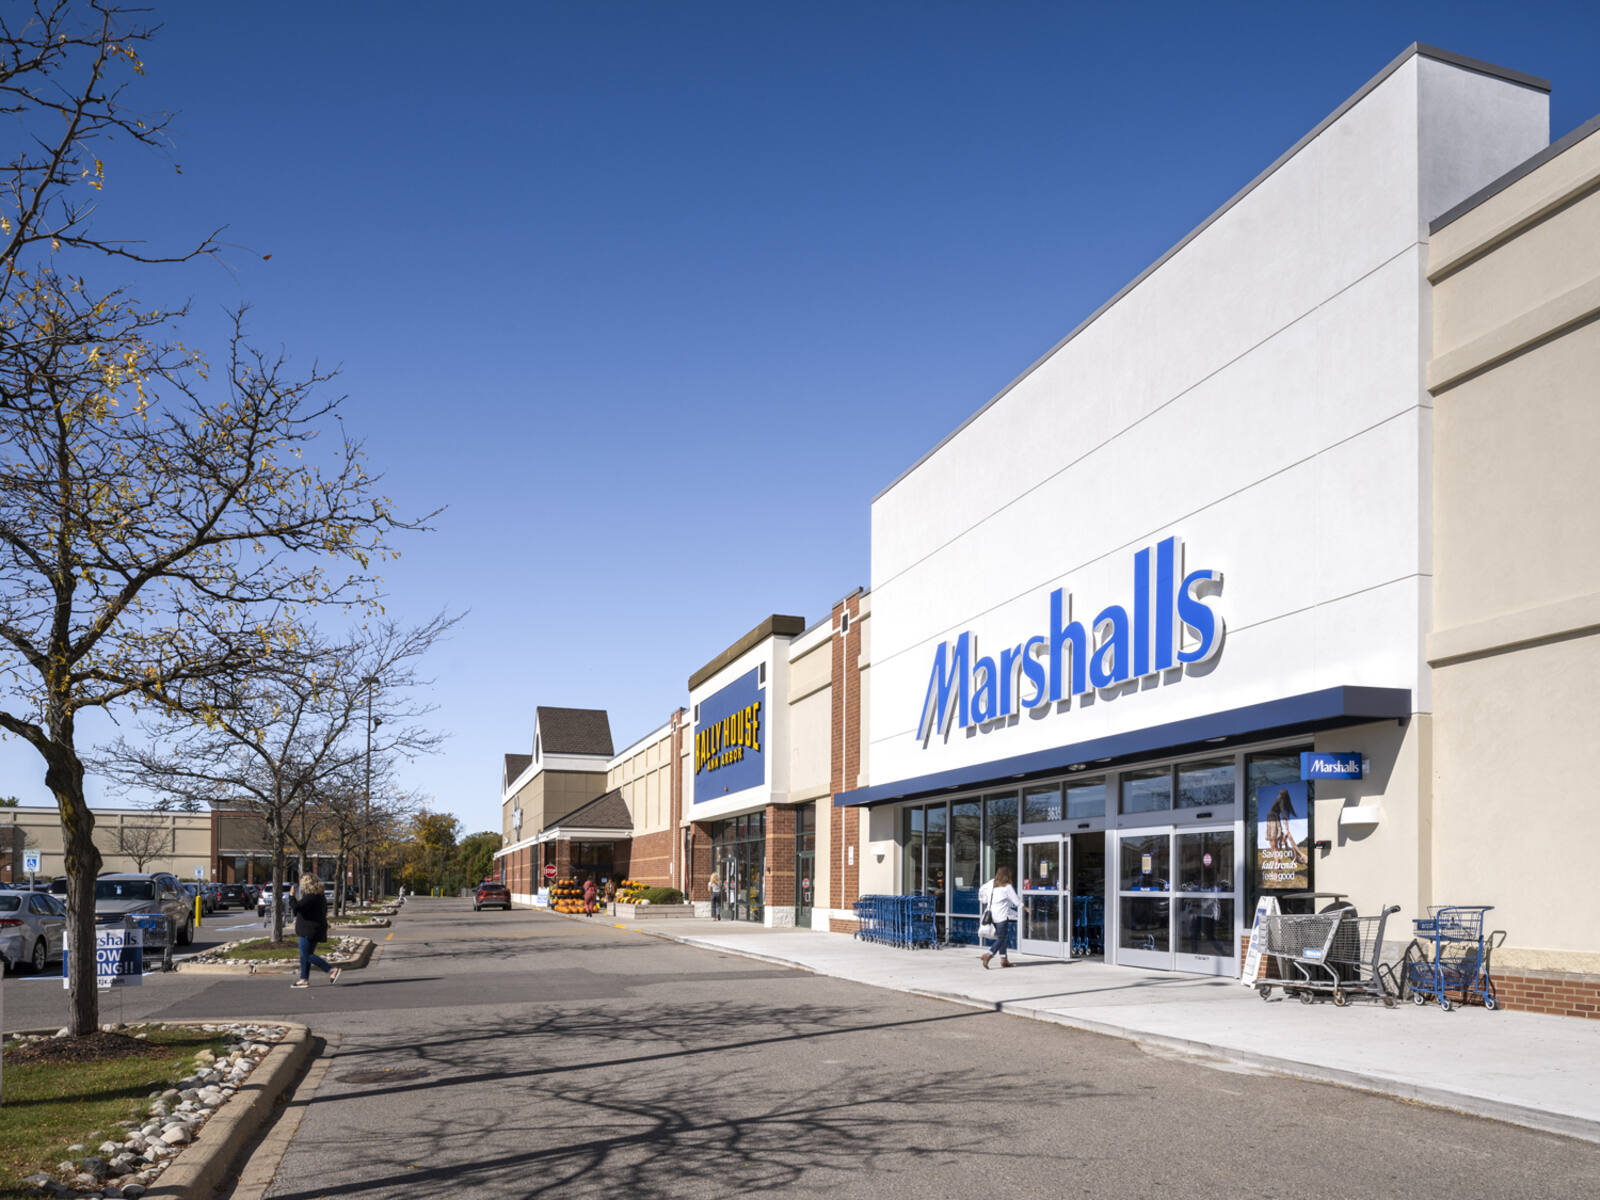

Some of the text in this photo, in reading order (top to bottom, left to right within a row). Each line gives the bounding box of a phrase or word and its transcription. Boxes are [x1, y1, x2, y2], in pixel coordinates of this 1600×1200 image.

[916, 535, 1223, 742] Marshalls
[695, 702, 760, 775] RALLY HOUSE
[721, 747, 743, 767] ARBOR
[1310, 760, 1360, 773] Marshalls
[1262, 850, 1284, 859] Saving
[1278, 872, 1295, 882] good
[96, 932, 137, 946] shalls
[96, 950, 121, 962] OW
[97, 962, 134, 975] ING!!
